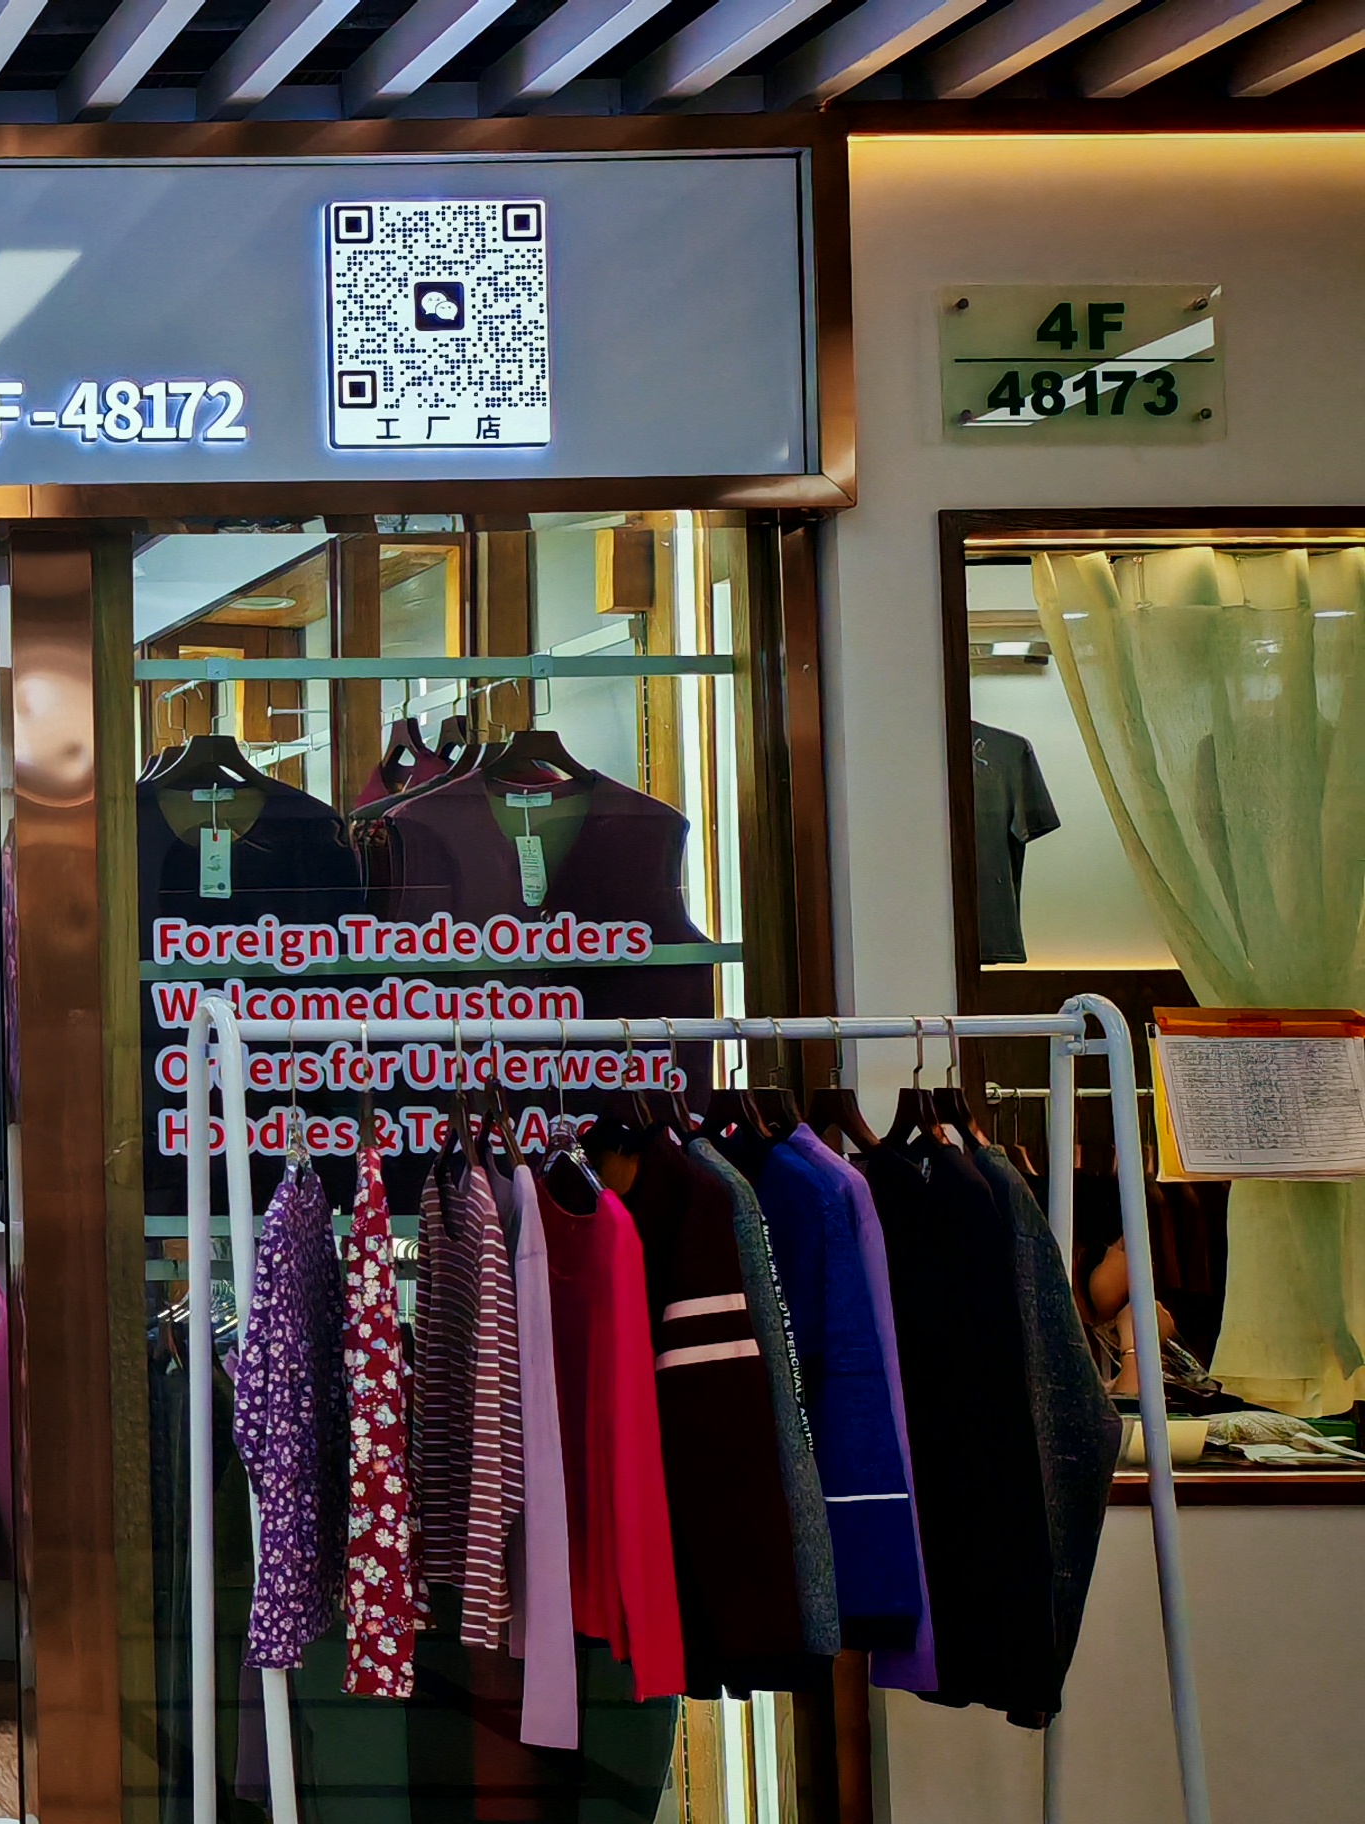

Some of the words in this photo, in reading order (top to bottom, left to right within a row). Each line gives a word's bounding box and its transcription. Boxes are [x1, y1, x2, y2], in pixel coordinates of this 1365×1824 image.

[1036, 302, 1125, 350] 4F
[987, 370, 1179, 416] 48173
[375, 414, 501, 440] 工厂店
[159, 920, 335, 967] Foreign
[346, 918, 478, 956] Trade
[490, 918, 648, 956] Orders
[158, 984, 580, 1021] WlcomedCustom
[161, 1051, 320, 1086] Oers
[330, 1047, 397, 1085] for
[165, 1112, 355, 1151] Hodes
